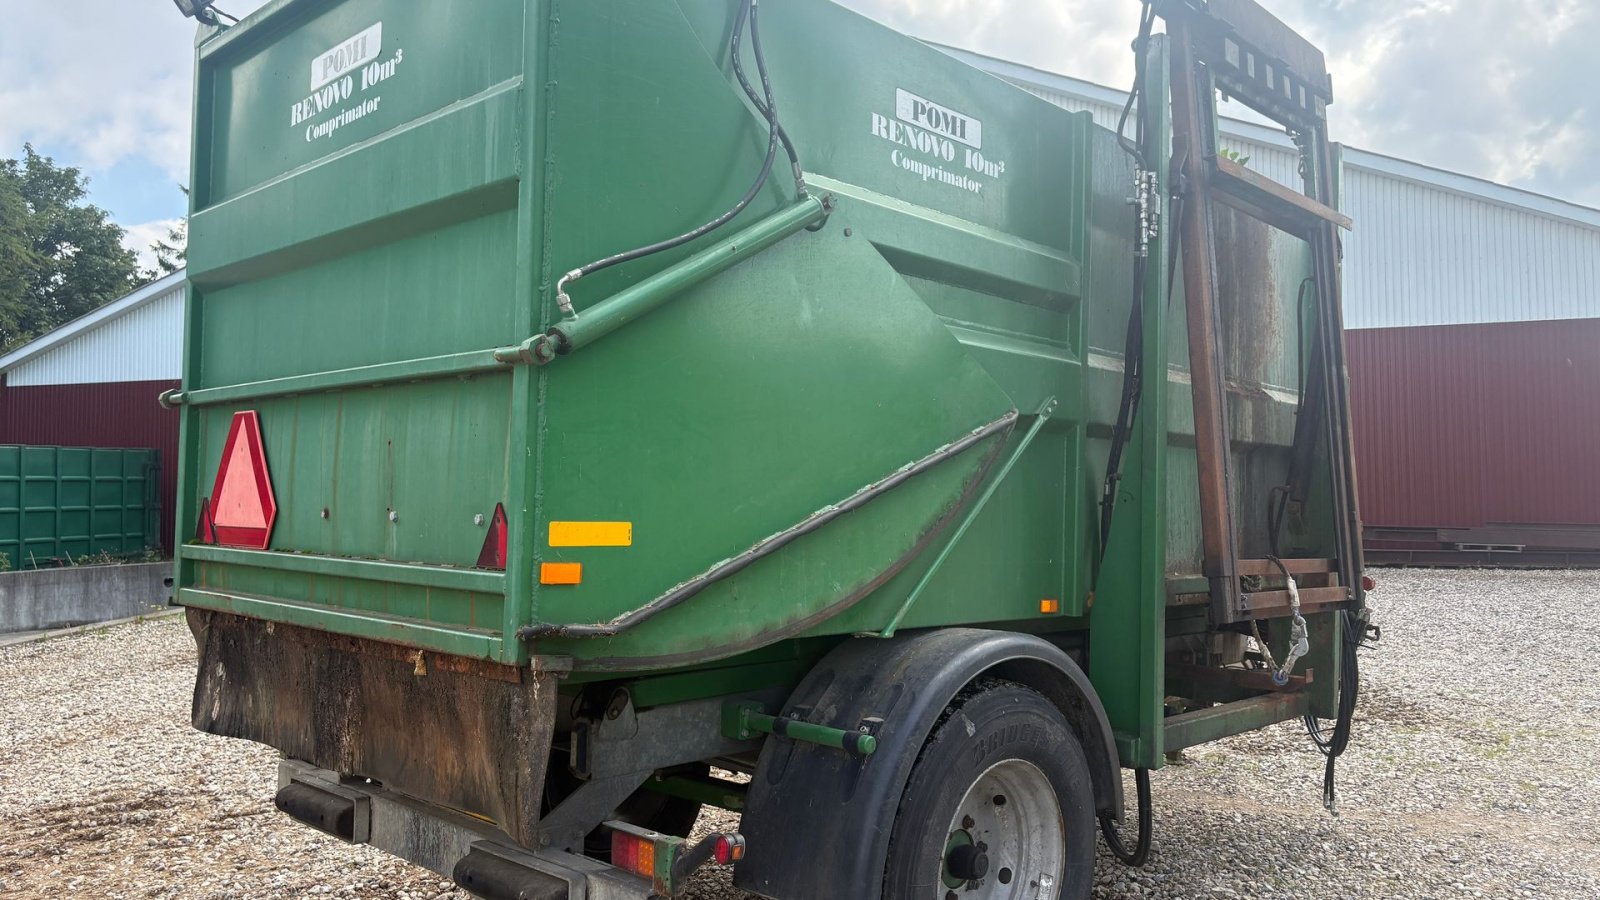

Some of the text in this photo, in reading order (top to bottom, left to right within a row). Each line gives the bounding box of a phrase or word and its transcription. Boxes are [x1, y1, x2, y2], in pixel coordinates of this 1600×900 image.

[321, 34, 368, 81] POMI
[290, 75, 353, 127] RENOVO
[306, 96, 381, 142] Comprimator
[912, 98, 967, 140] POMI
[871, 112, 955, 162] RENOVO
[891, 149, 982, 193] Comprimator
